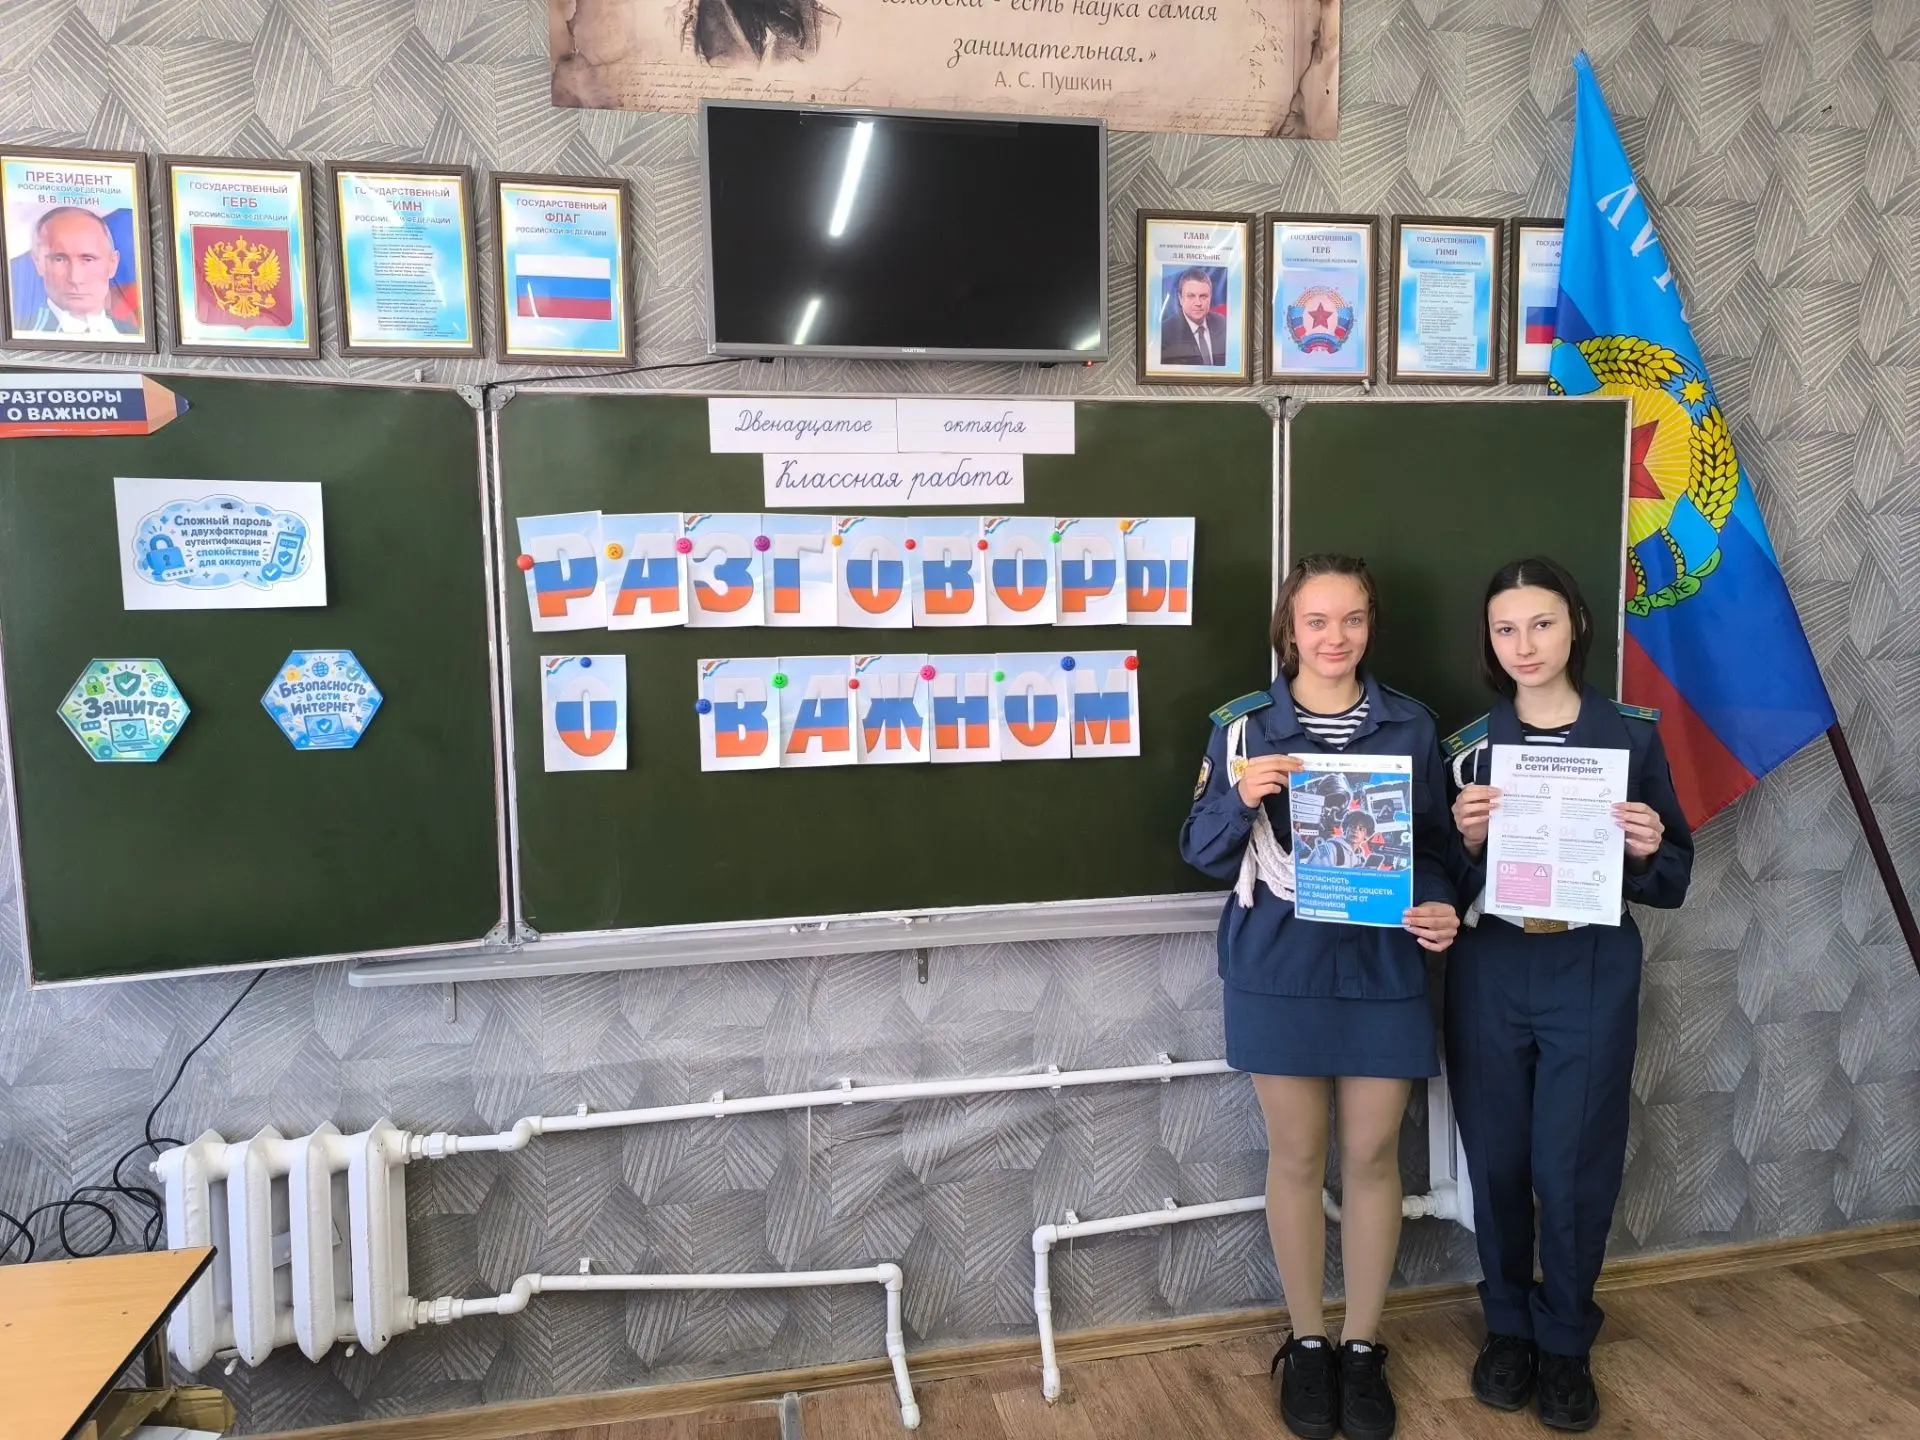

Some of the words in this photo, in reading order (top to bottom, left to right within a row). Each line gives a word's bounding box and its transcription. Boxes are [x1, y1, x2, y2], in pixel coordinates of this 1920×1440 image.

[1011, 0, 1064, 14] есть
[1073, 0, 1140, 25] наука
[1148, 5, 1218, 21] самая
[995, 71, 1012, 88] А.
[1018, 72, 1035, 89] С.
[1042, 71, 1113, 94] Пушкин
[25, 170, 113, 186] ПРЕЗИДЕНТ
[74, 186, 122, 195] ФЕДЕРАЦИИ
[189, 181, 288, 194] ГОСУДАРСТВЕННЫЙ
[63, 196, 100, 206] ПУТИН
[222, 196, 258, 208] ГЕРБ
[386, 200, 422, 212] ИМН
[516, 198, 607, 211] ГОСУДАРСТВЕННЫЙ
[544, 212, 581, 224] ФЛАГ
[1183, 231, 1210, 241] ГЛАВА
[1312, 246, 1331, 254] ГЕРБ
[1435, 248, 1458, 256] ГИМН
[0, 390, 123, 404] РАЗГОВОРЫ
[7, 407, 22, 421] О
[27, 406, 118, 420] ВАЖНОМ
[734, 409, 873, 440] Двенадцатое
[943, 411, 1027, 442] октября
[775, 459, 904, 489] Классная
[906, 457, 1014, 500] работа
[174, 515, 229, 526] Сложный
[232, 517, 272, 527] пароль
[191, 527, 268, 537] двухфакторная
[185, 537, 262, 548] аутентификация
[196, 547, 260, 557] спокойствие
[199, 559, 217, 568] для
[219, 559, 262, 567] аккаунта
[531, 532, 1188, 618] РАЗГОВОРЫ
[315, 692, 340, 700] сети
[83, 697, 170, 719] Защита
[554, 675, 617, 758] О
[714, 669, 1130, 759] ВАЖНОМ
[1521, 753, 1598, 765] Безопасность
[1525, 763, 1548, 771] сети
[1552, 763, 1603, 775] Интернет
[1500, 863, 1517, 875] 05
